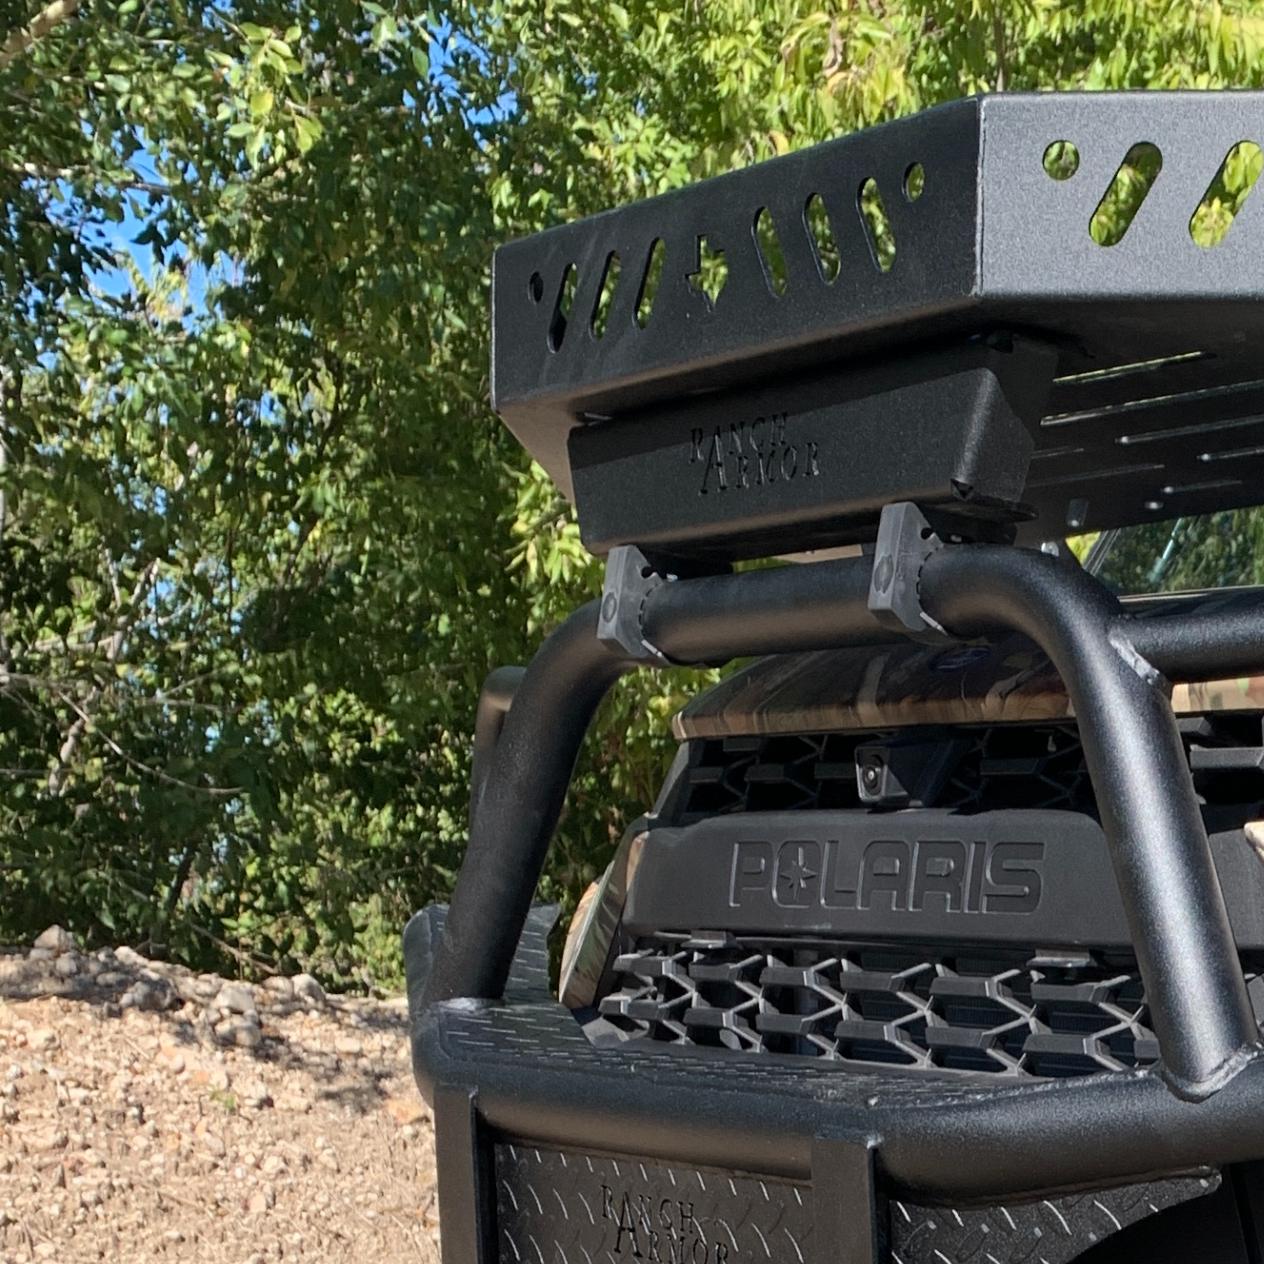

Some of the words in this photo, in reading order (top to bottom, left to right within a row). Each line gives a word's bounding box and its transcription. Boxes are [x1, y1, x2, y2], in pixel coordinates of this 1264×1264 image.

[688, 411, 788, 464] RANCH
[698, 425, 820, 496] ARMOR
[728, 837, 1047, 915] POLARIS
[600, 1184, 695, 1235] RANCH
